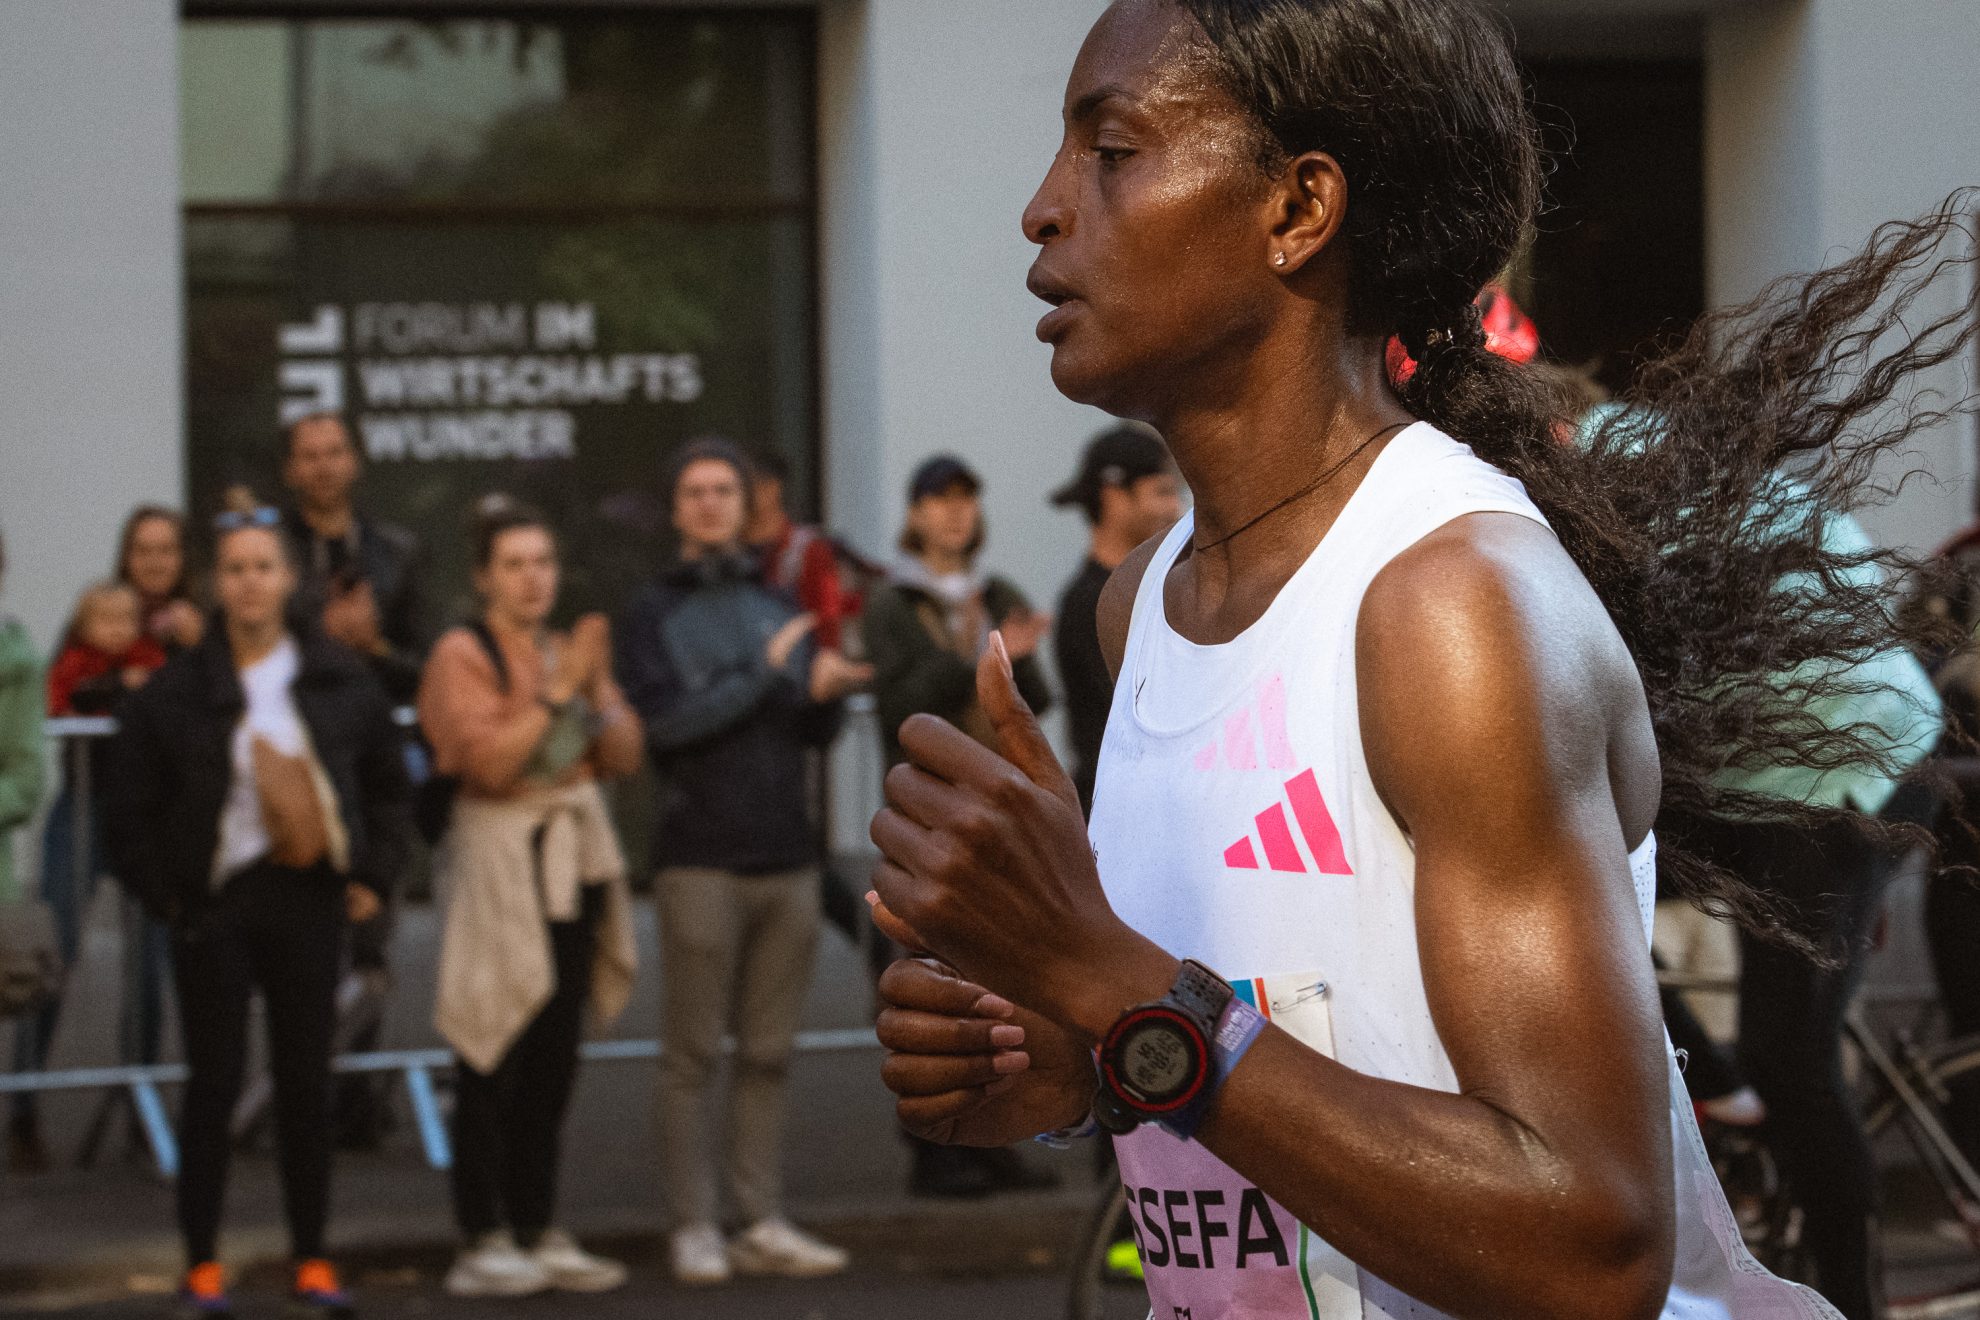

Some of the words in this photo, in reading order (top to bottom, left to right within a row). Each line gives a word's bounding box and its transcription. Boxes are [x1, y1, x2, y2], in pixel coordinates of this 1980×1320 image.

[355, 304, 525, 351] FORUM
[536, 304, 596, 350] IM
[360, 356, 700, 403] WIRTSCHAFTS
[362, 411, 574, 459] WUNDER
